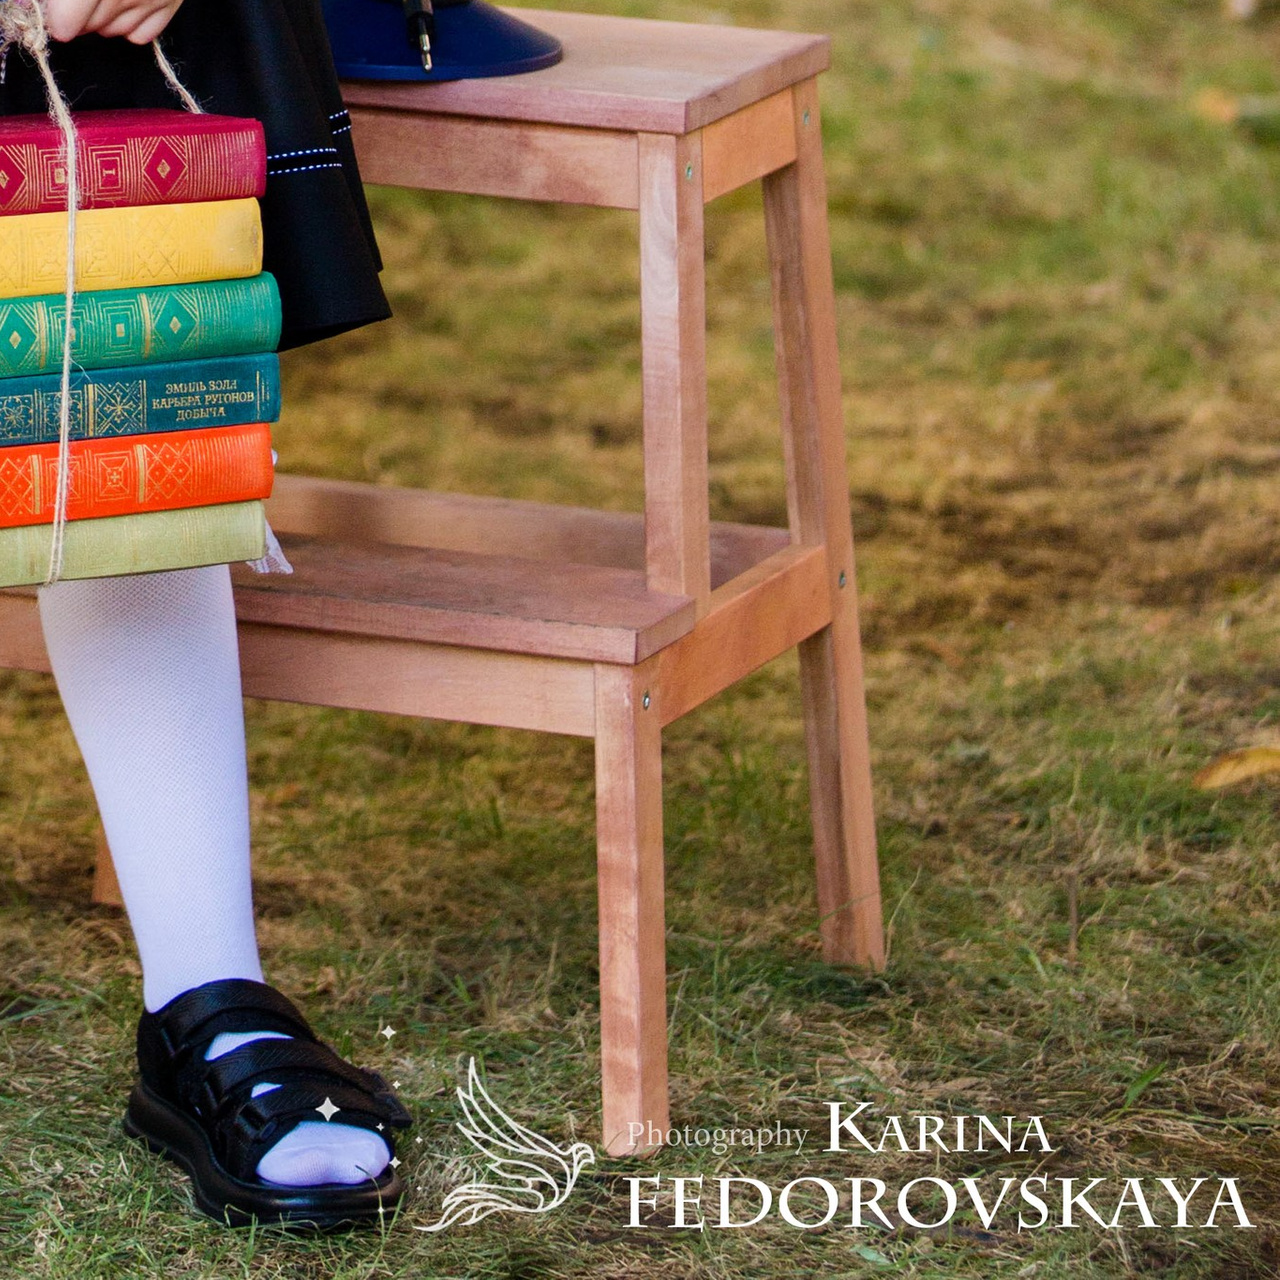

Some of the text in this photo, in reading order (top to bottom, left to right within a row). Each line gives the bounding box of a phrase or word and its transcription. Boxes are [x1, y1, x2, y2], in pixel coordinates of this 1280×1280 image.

[166, 379, 237, 395] ЭМИЛЬ ЗОЛЯ
[152, 391, 254, 409] КАРЬЕРА РУГОНОВ
[176, 406, 226, 421] ДОБЫЧА
